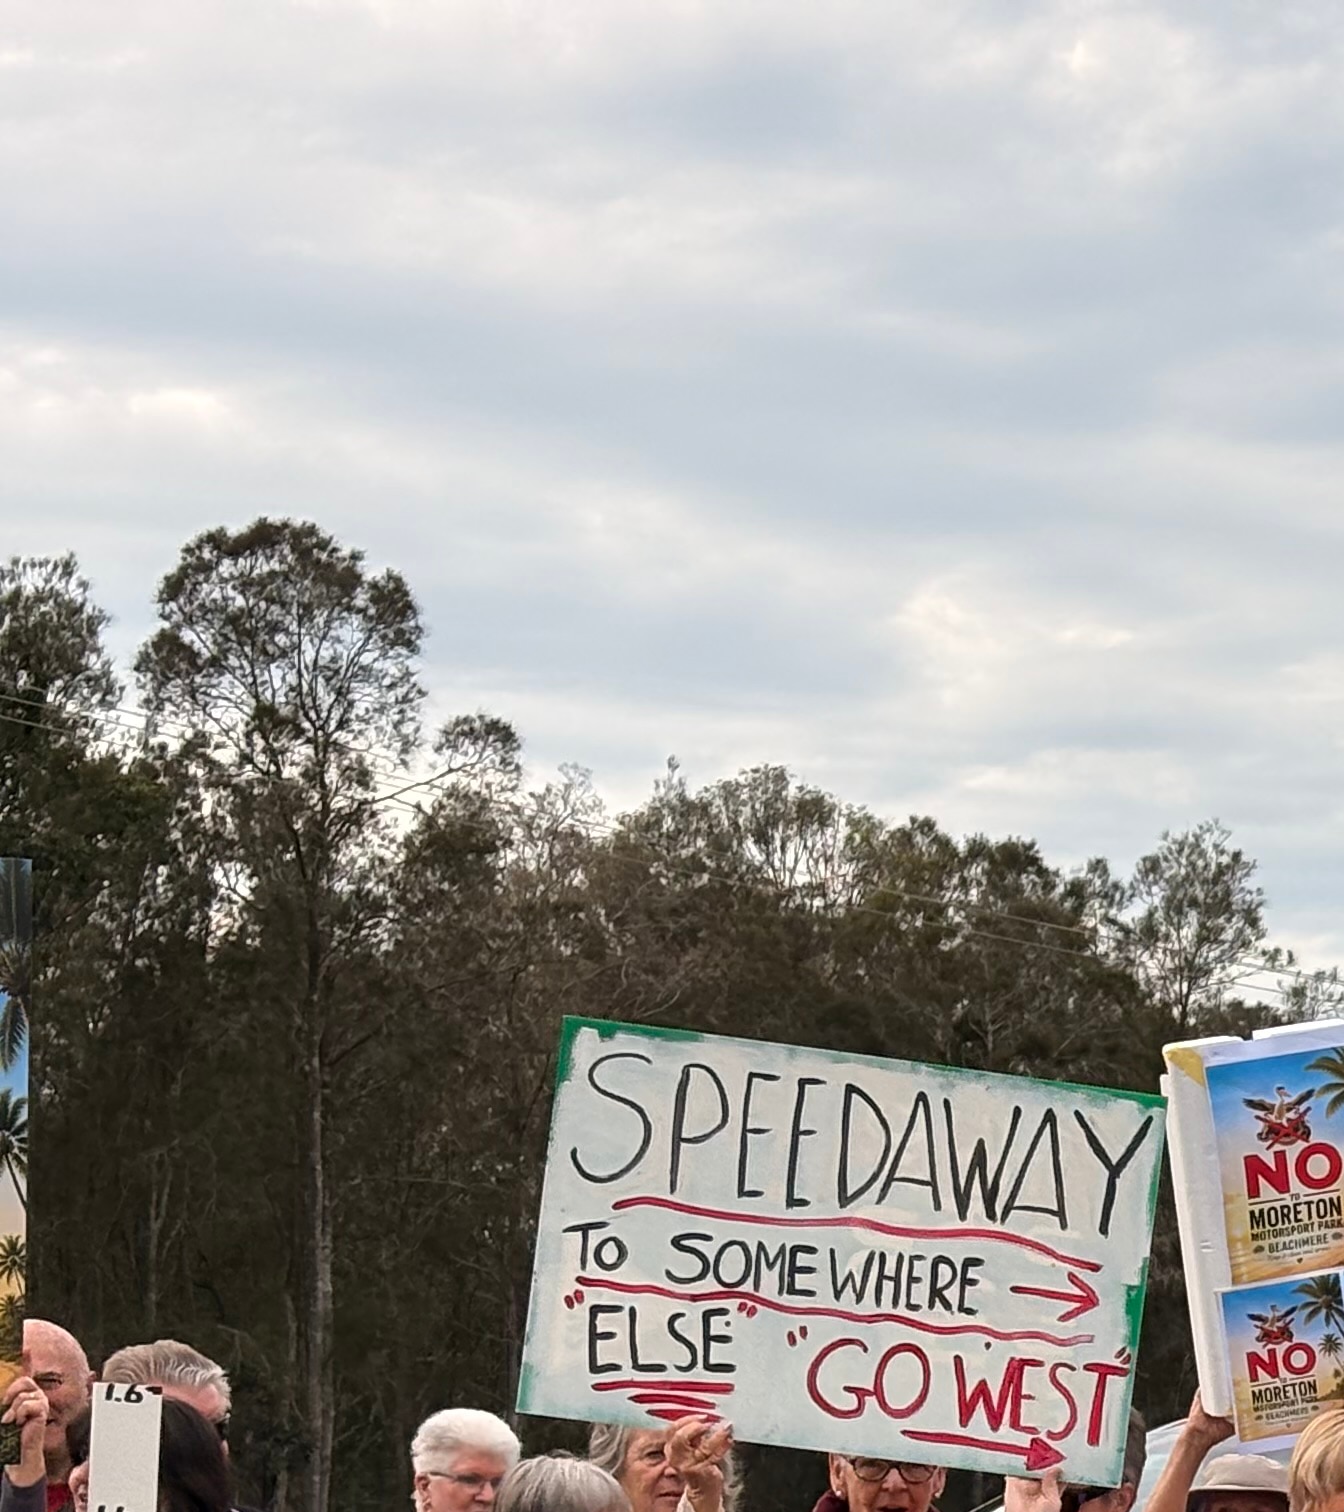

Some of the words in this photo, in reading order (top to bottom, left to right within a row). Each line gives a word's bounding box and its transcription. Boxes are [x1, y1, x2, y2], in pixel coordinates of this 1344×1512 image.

[571, 1053, 1154, 1237] SPEEDAWAY
[1243, 1143, 1343, 1199] NO
[1249, 1197, 1343, 1230] MORETON
[1251, 1221, 1315, 1242] MOTORSPORT
[1317, 1218, 1344, 1230] PARK
[1268, 1233, 1329, 1254] BEACHMERE
[666, 1232, 986, 1315] SOMEWHERE
[1246, 1343, 1316, 1382] NO
[1251, 1379, 1317, 1405] MORETON
